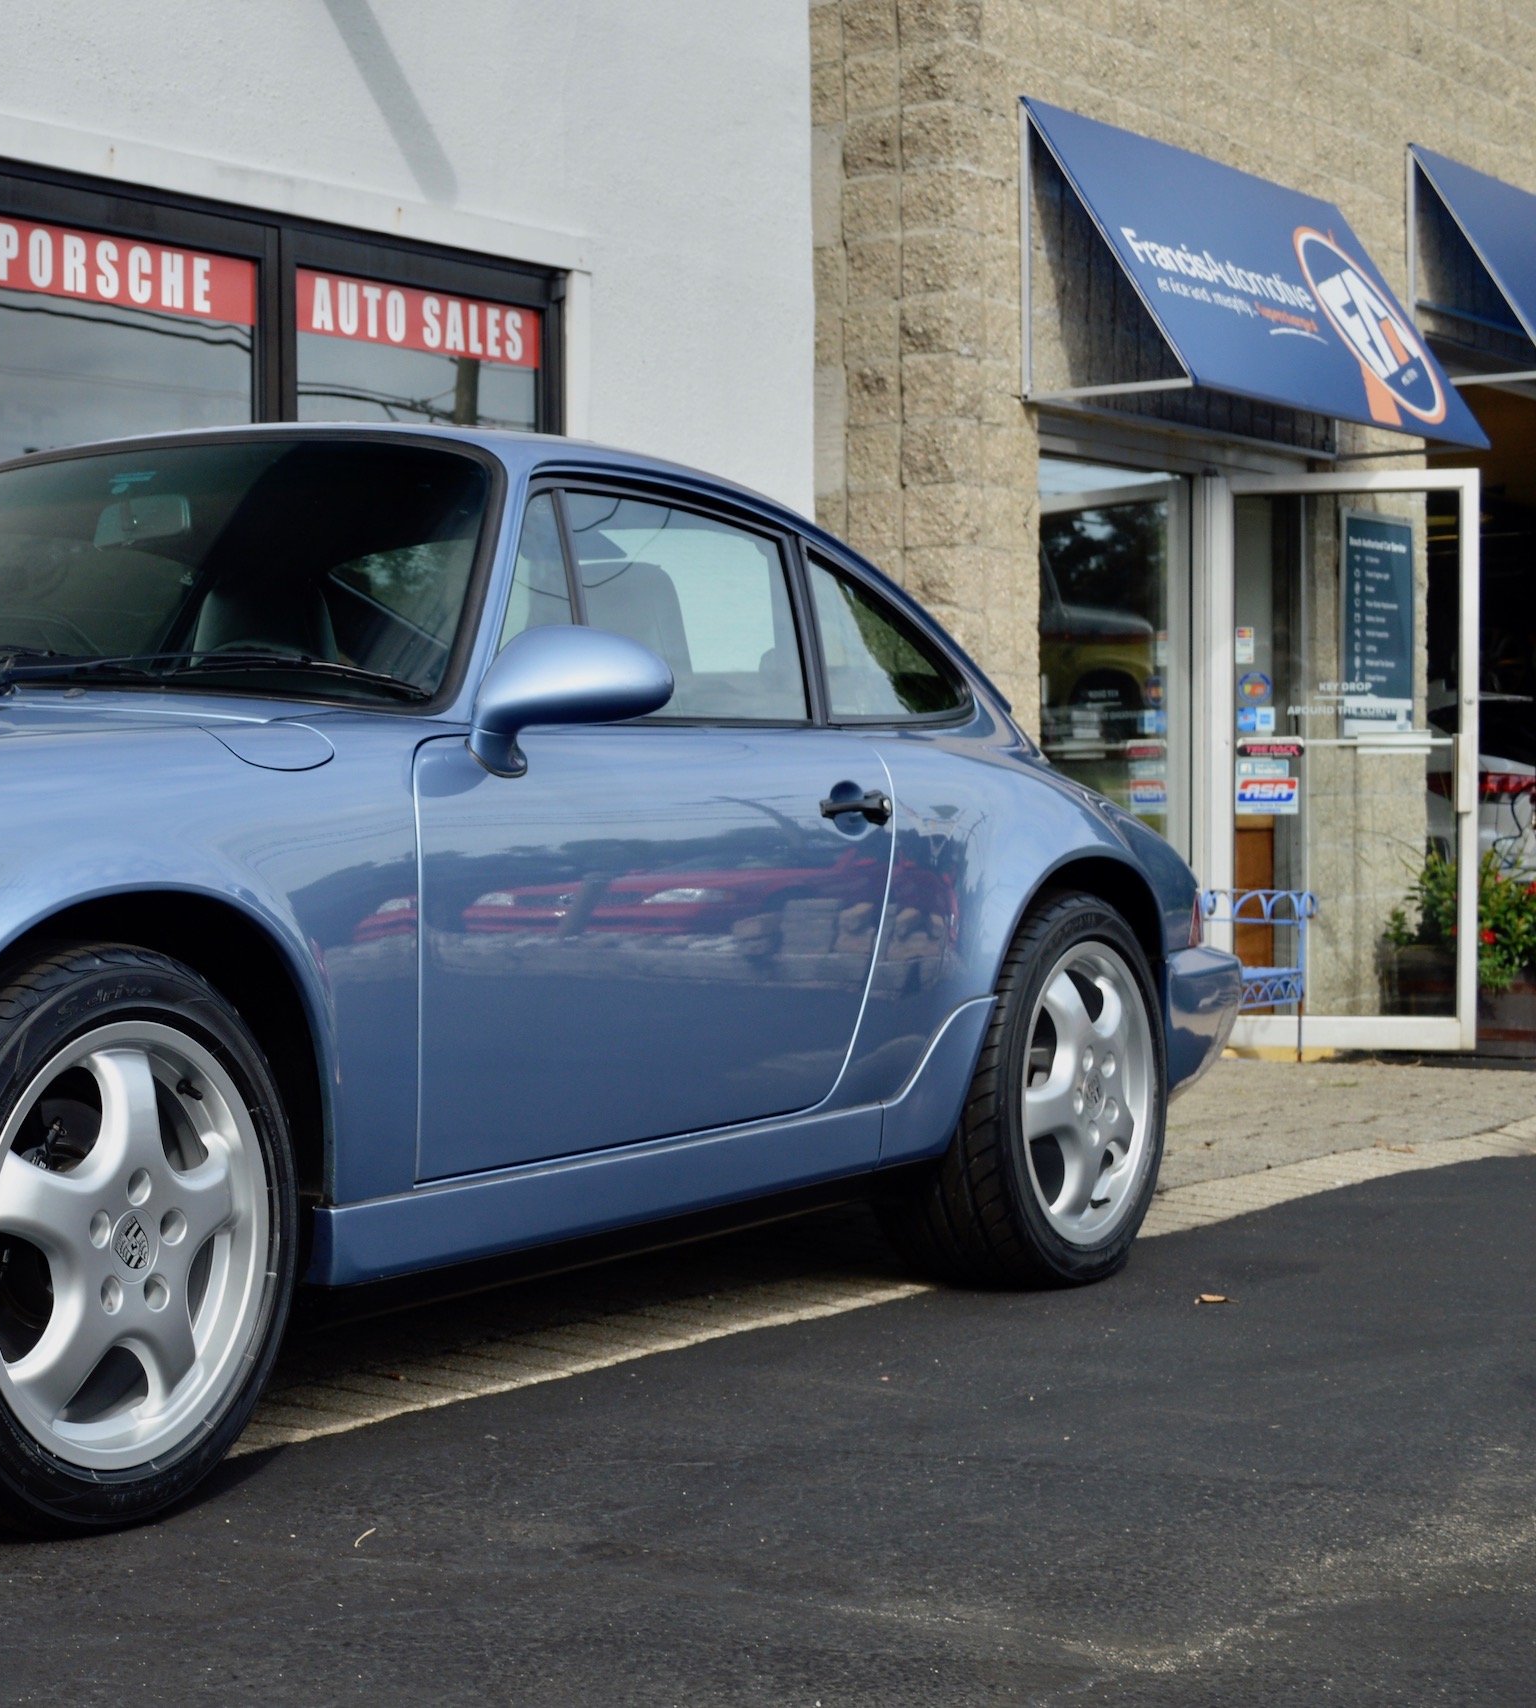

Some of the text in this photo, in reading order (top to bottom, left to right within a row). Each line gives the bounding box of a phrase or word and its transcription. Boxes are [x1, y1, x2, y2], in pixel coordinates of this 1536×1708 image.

[311, 277, 524, 363] AUTO SALES
[1319, 682, 1373, 692] KEY DROP
[1287, 705, 1335, 715] AROUND
[1338, 705, 1358, 715] THE
